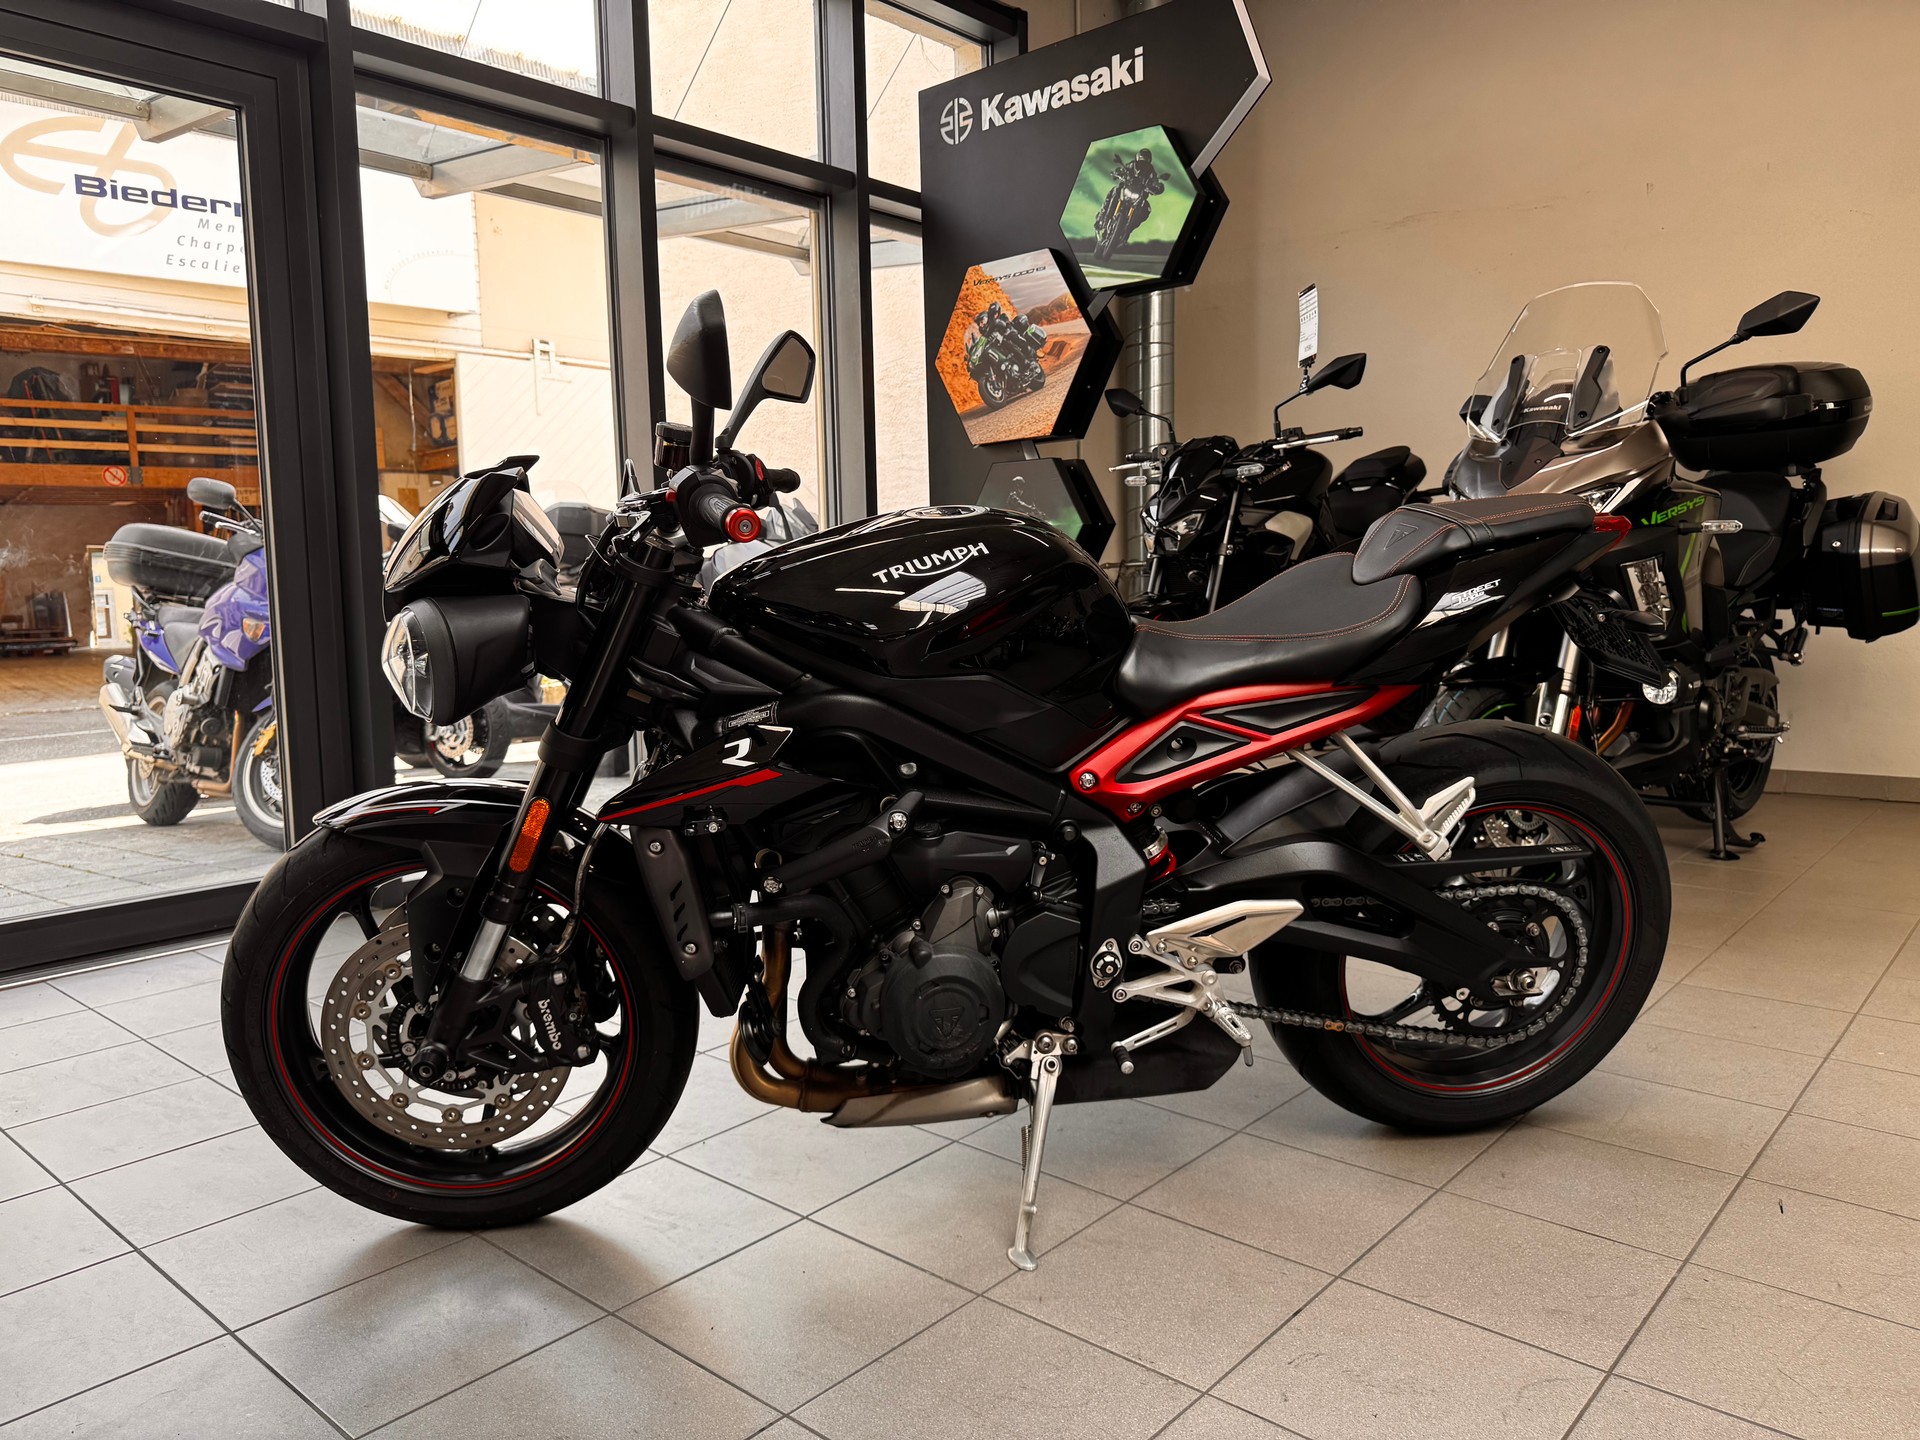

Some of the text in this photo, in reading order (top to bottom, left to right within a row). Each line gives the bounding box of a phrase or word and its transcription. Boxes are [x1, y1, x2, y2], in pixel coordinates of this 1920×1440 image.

[981, 45, 1144, 131] Kawasaki
[197, 217, 243, 235] Men
[1641, 495, 1705, 526] VERSYS
[872, 542, 990, 583] TRIUMPH
[537, 998, 563, 1050] brembo
